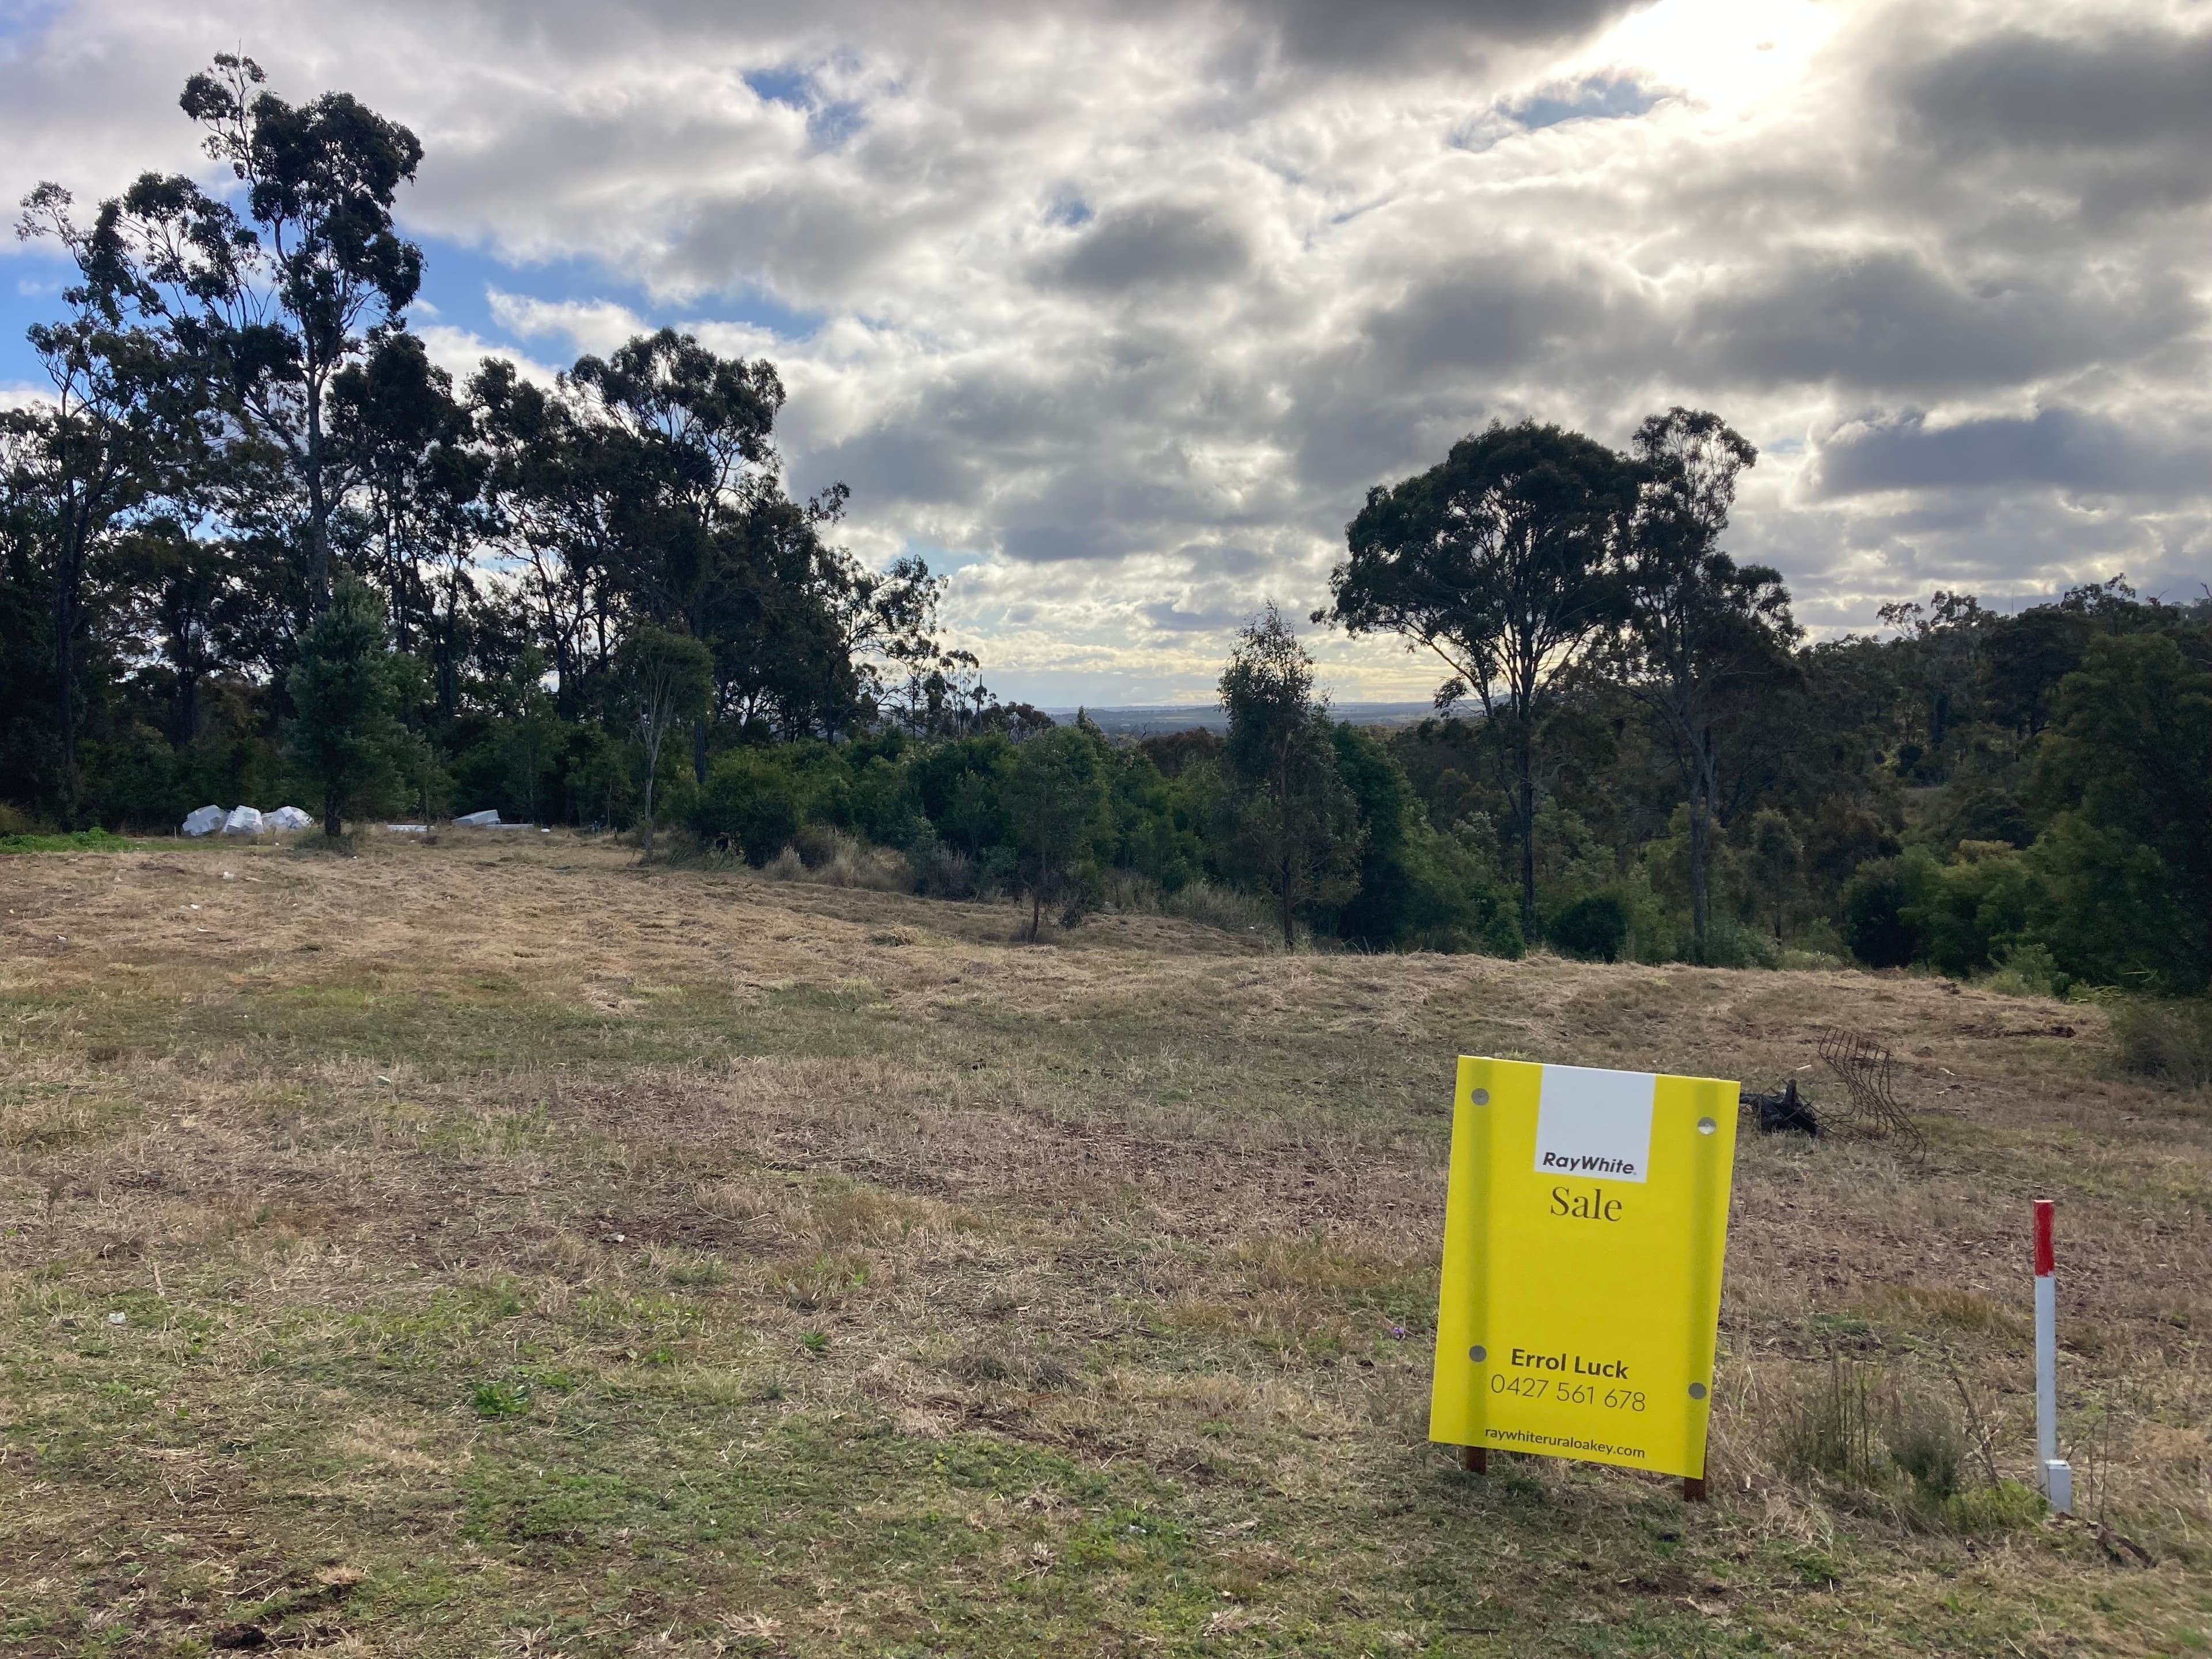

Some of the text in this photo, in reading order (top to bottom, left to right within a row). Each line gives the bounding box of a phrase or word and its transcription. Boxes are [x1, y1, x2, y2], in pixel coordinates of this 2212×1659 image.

[1550, 1187, 1622, 1221] Sale
[1511, 1349, 1629, 1380] Errol Luck
[1491, 1374, 1646, 1411] 0427 561 678
[1485, 1427, 1645, 1458] raywhiteruraloakey.com
